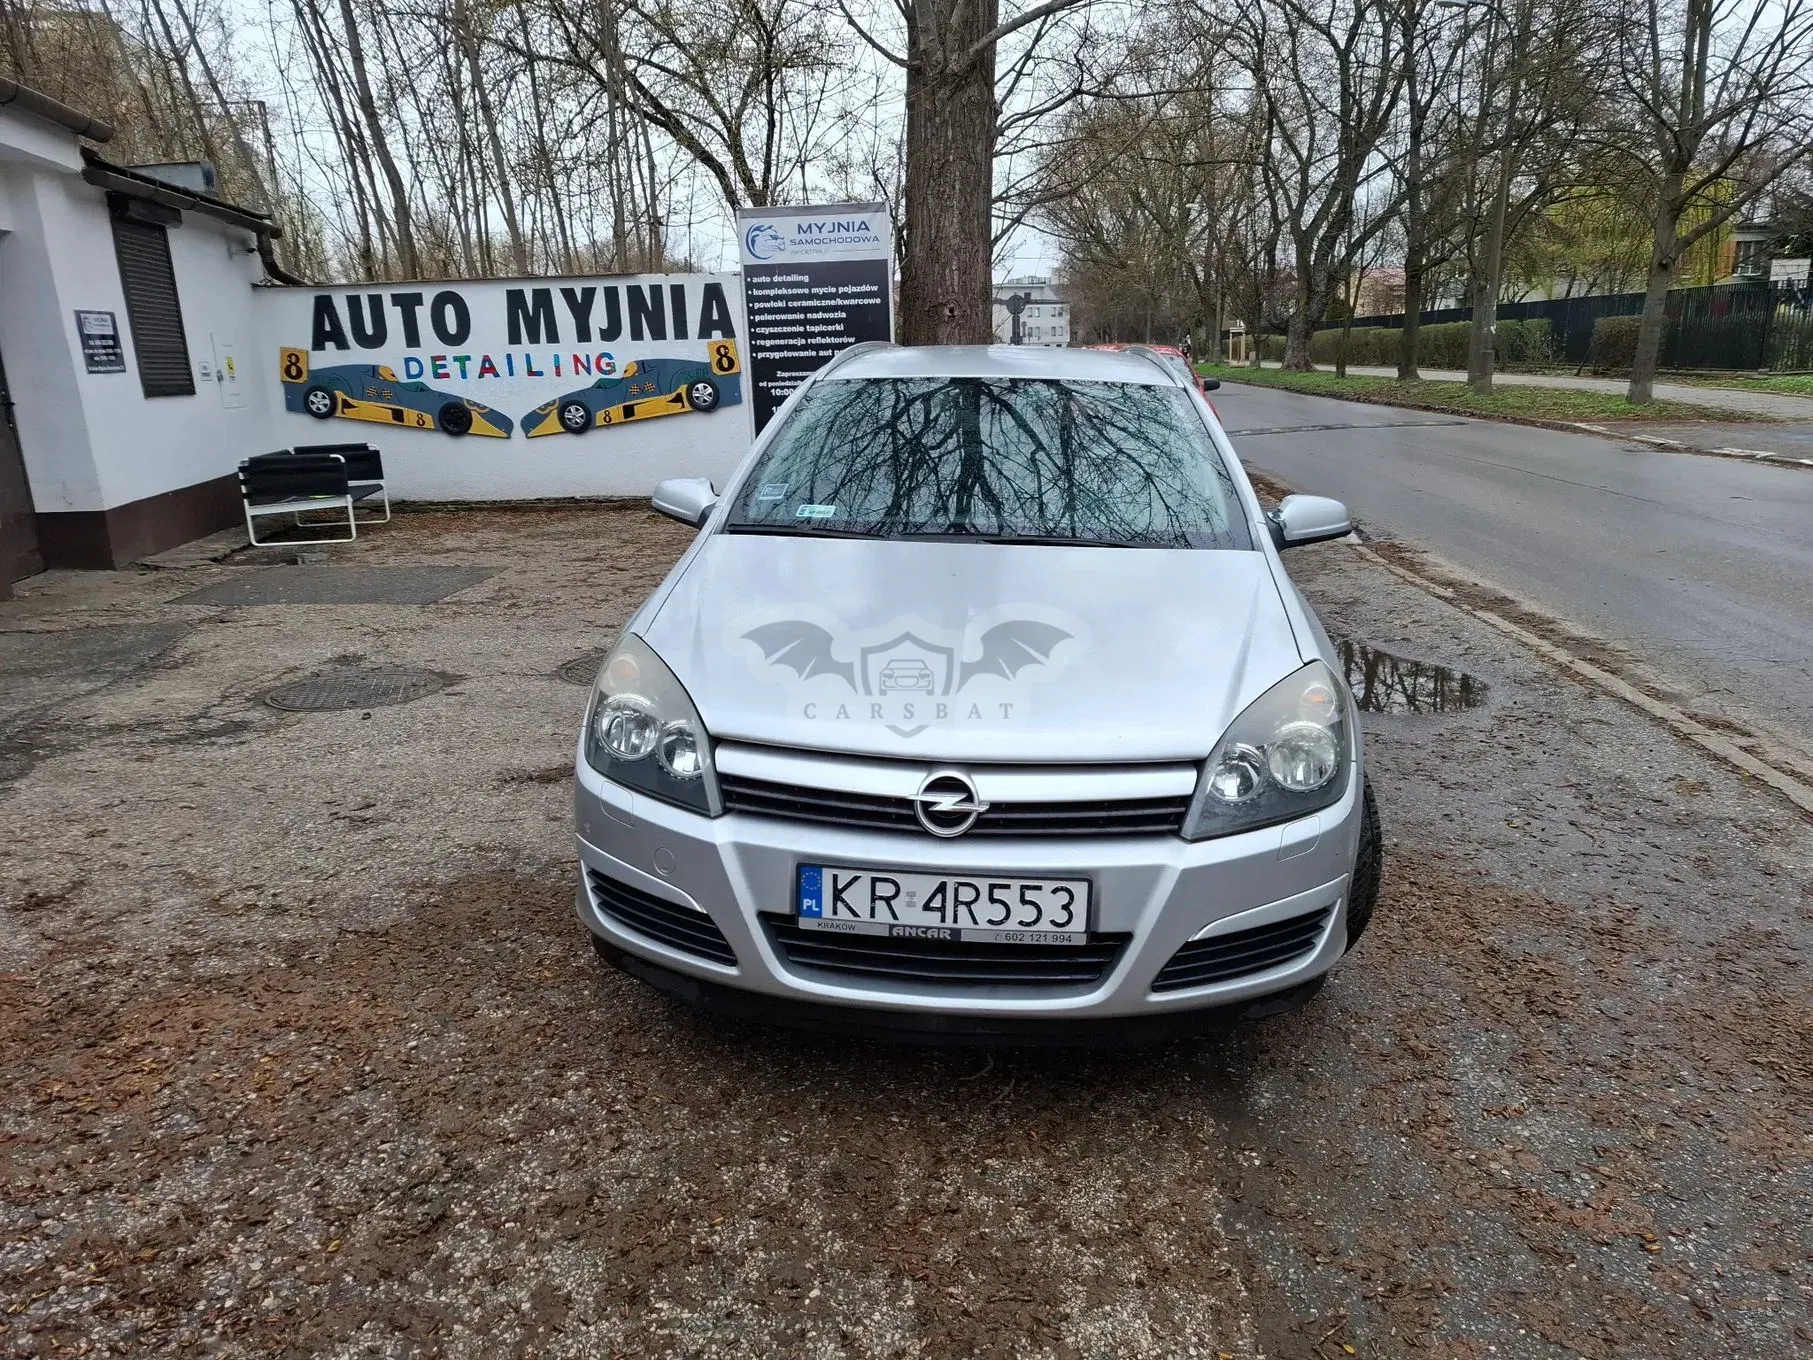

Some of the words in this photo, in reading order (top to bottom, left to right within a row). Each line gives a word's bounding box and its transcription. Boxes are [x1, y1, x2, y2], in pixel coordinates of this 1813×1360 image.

[797, 220, 871, 235] MYJNIA
[789, 235, 880, 246] SAMOCHODOWA
[772, 274, 809, 283] detailing
[752, 287, 809, 296] kompleksowe
[811, 286, 837, 295] mycie
[838, 284, 879, 294] pojazdów
[754, 299, 786, 309] powłoki
[787, 297, 881, 307] ceramiczne/kwarcowe
[311, 290, 471, 351] AUTO
[505, 283, 737, 345] MYJNIA
[754, 312, 805, 322] polerowanie
[806, 310, 847, 320] nadwozia
[755, 324, 804, 335] czyszczenie
[806, 323, 844, 333] tapicerki
[756, 337, 806, 347] regeneracja
[807, 336, 856, 345] reflektorów
[714, 344, 735, 373] 8
[757, 349, 817, 359] przygotowanie
[818, 347, 833, 356] aut
[284, 352, 303, 380] 8
[403, 352, 617, 380] DETAILING
[416, 412, 426, 427] 8
[603, 409, 613, 424] 8
[803, 899, 820, 912] PL
[832, 873, 901, 921] KR
[922, 880, 1075, 929] 4R553
[817, 921, 856, 931] KRAKÓW
[892, 926, 952, 940] ANCAR
[1005, 932, 1025, 942] 602
[1029, 933, 1048, 942] 121
[1052, 934, 1072, 943] 994
